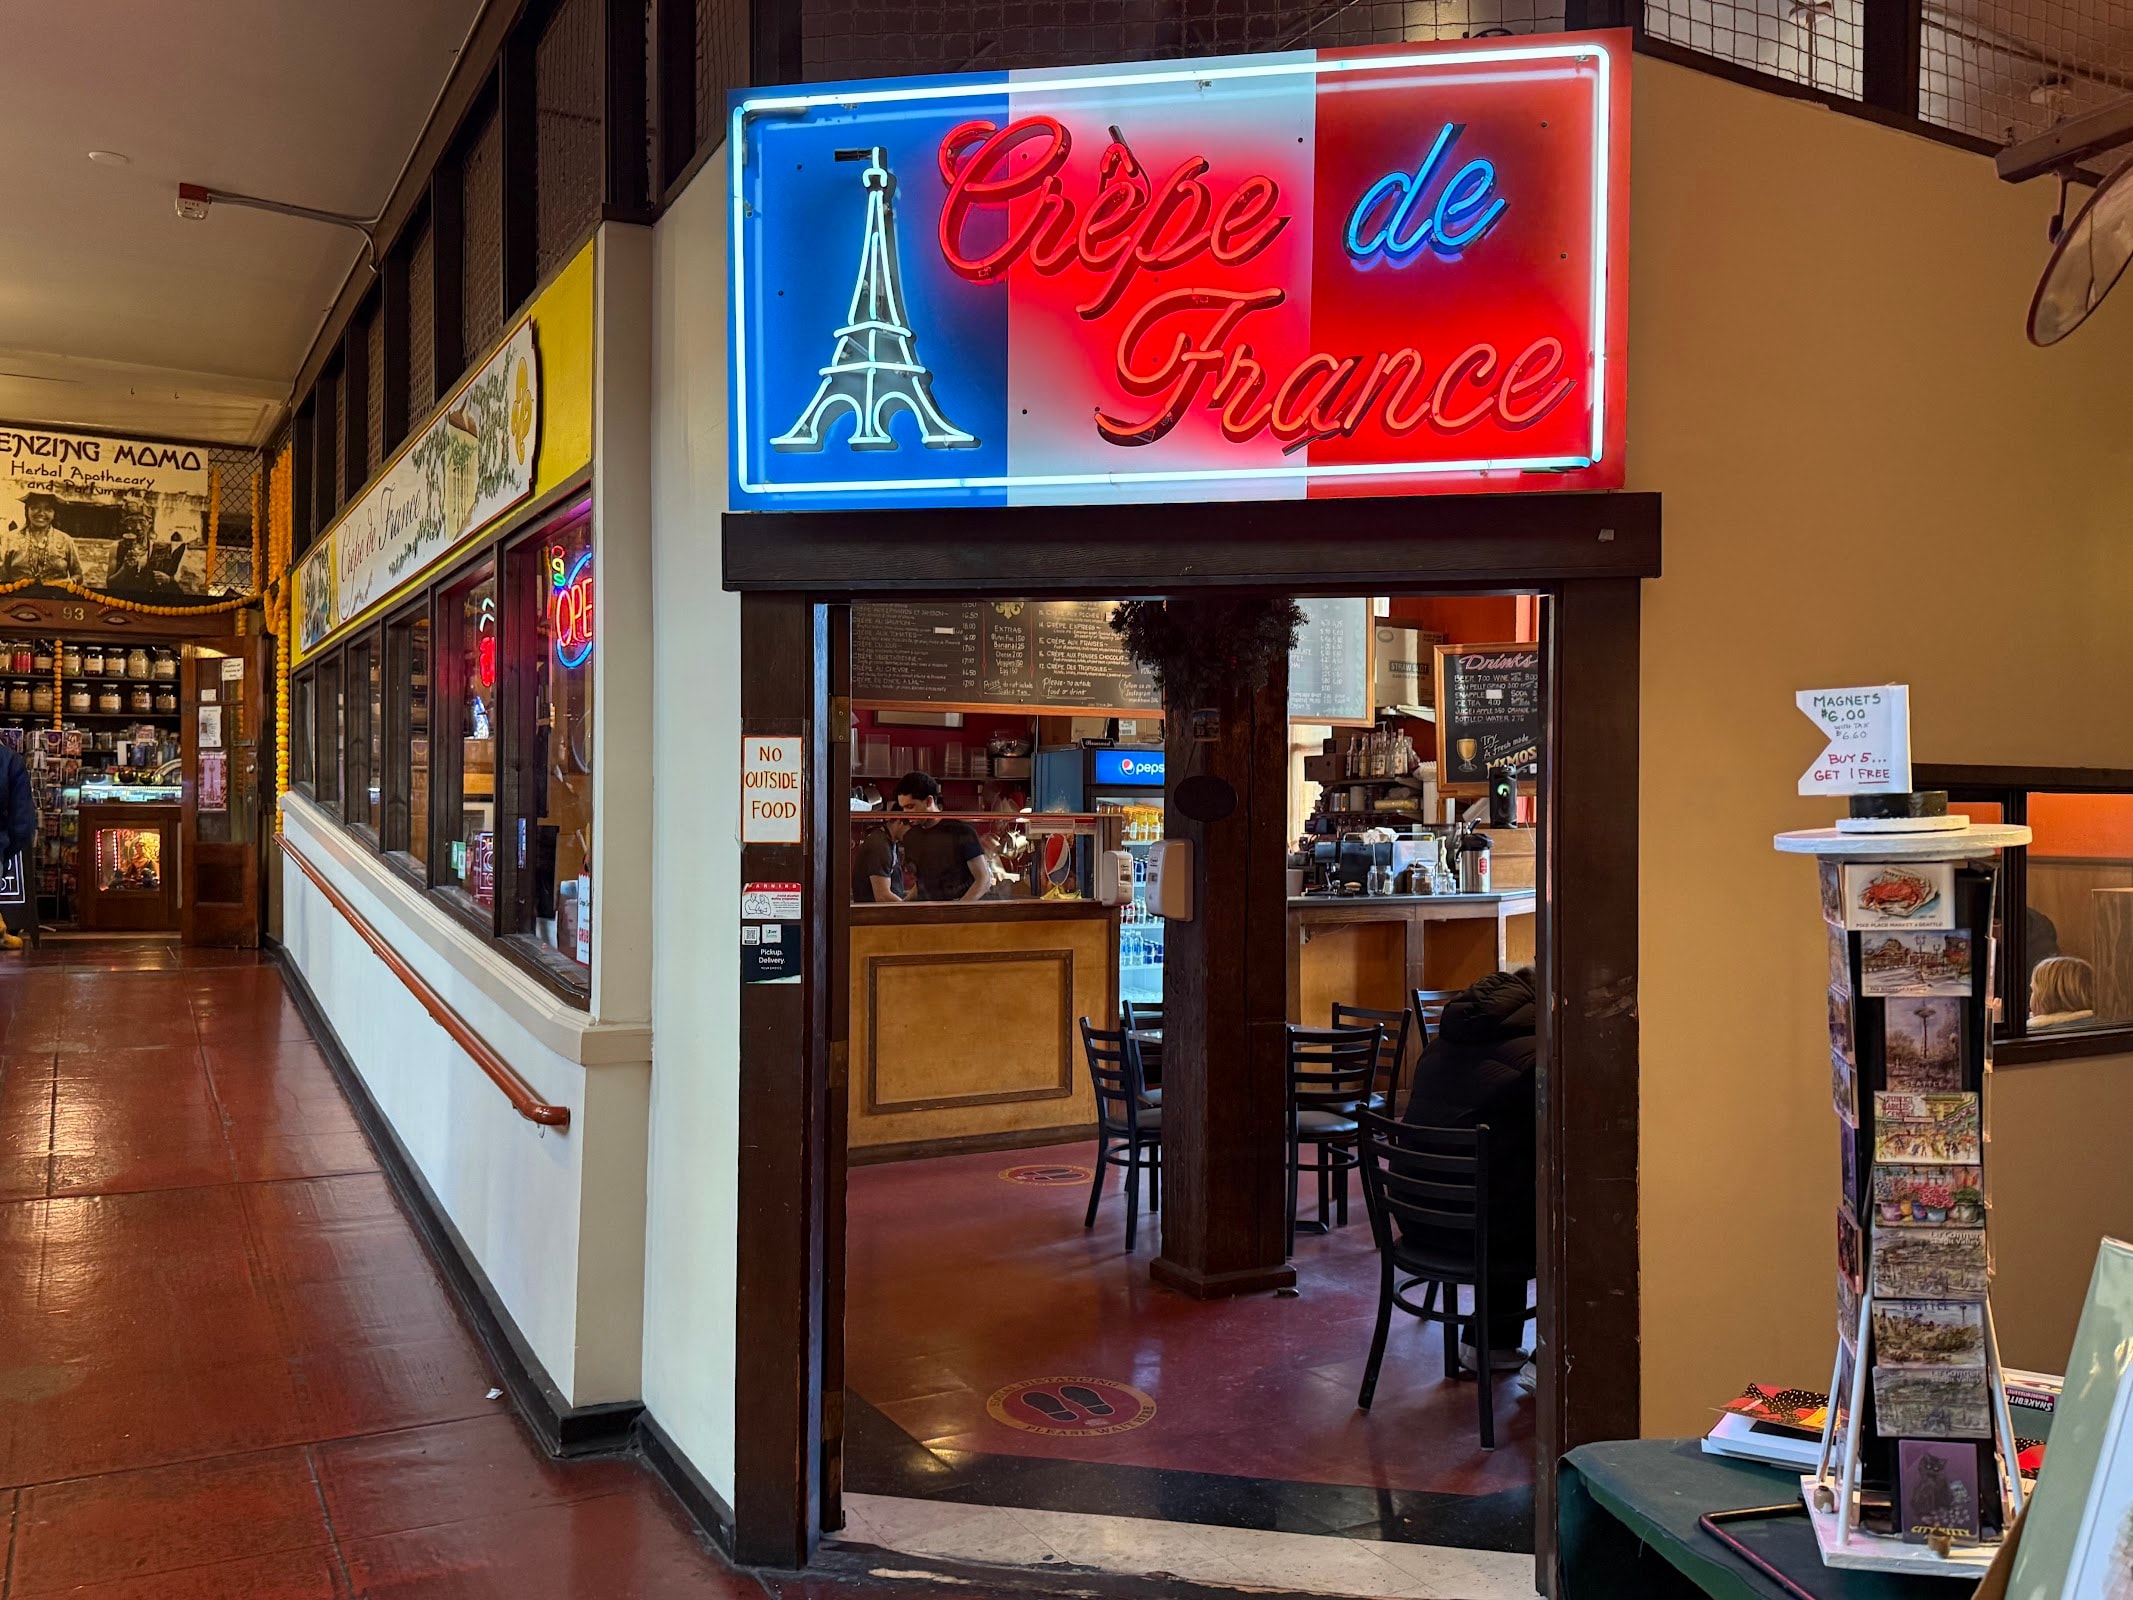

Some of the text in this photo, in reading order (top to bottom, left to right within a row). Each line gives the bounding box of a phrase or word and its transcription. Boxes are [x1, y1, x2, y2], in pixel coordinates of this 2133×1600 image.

[1345, 122, 1511, 264] de
[1095, 286, 1577, 453] France
[114, 444, 201, 471] MOMO
[11, 460, 155, 489] Herbal Apothecary
[27, 480, 54, 491] and
[378, 482, 421, 551] France
[63, 607, 84, 621] 93
[993, 624, 1022, 634] EXTRAS
[1458, 652, 1538, 670] Drinks
[1468, 699, 1481, 707] TEA
[1813, 693, 1882, 707] MAGNETS
[1480, 734, 1499, 749] Try
[759, 745, 782, 762] NO
[1828, 753, 1856, 765] BUY
[1135, 762, 1165, 775] peps
[1814, 769, 1840, 781] GET
[1858, 768, 1890, 778] FREE
[745, 771, 798, 790] OUTSIDE
[752, 800, 797, 819] FOOD
[760, 948, 784, 957] Pickup.
[758, 956, 786, 966] Delivery.
[1903, 1080, 1944, 1088] SEATTLE
[1902, 1302, 1949, 1311] SEATTLE
[1021, 1376, 1119, 1388] DISTANCING
[1025, 1425, 1093, 1436] PLEASE
[1911, 1525, 1936, 1534] CITY
